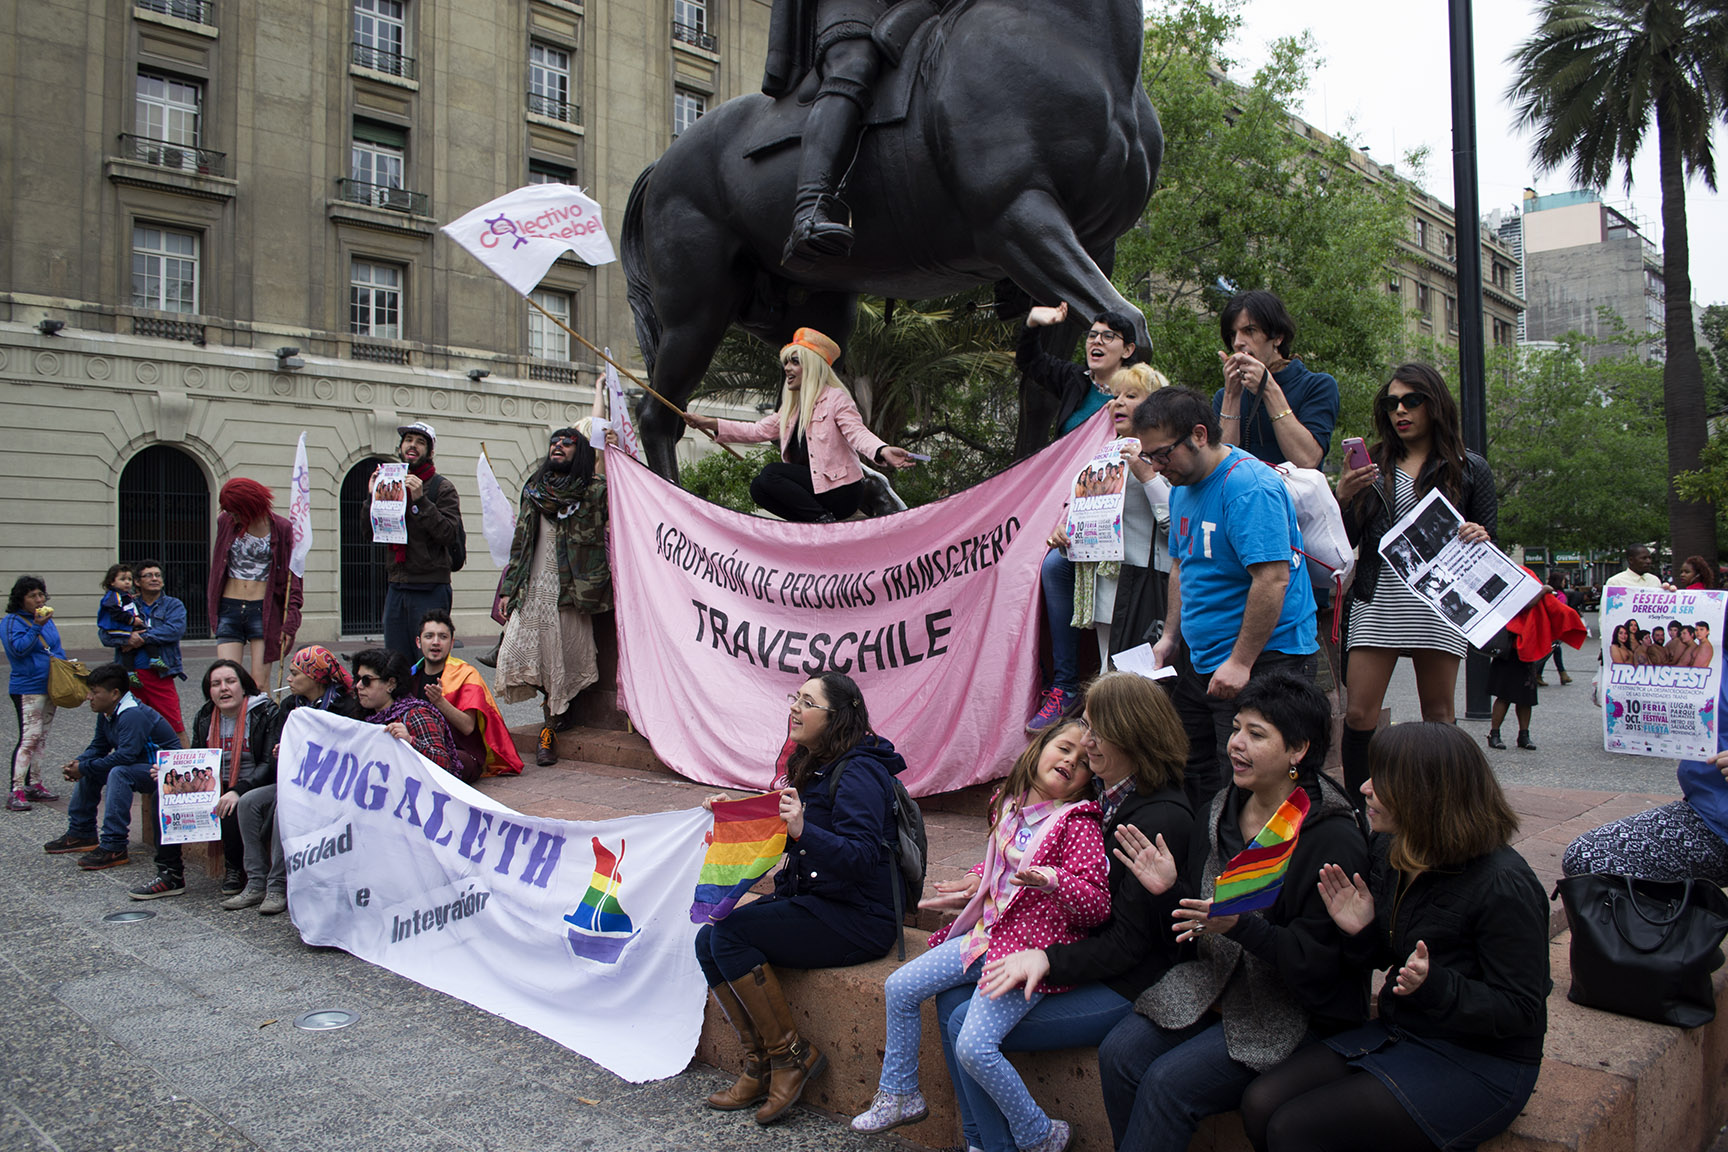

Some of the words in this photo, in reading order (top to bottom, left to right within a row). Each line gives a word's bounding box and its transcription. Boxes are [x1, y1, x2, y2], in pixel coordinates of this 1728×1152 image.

[1073, 493, 1122, 512] TRANSFEST
[1077, 522, 1084, 531] 10
[656, 522, 750, 597] AGRUPACIÓN
[752, 566, 778, 604] DE
[780, 570, 875, 609] PERSONAS
[882, 517, 1020, 601] TRANSGENERO
[1632, 594, 1677, 604] FESTEJA
[1682, 595, 1696, 605] TU
[1632, 605, 1668, 613] DERECHO
[1679, 606, 1694, 614] SER
[692, 599, 952, 676] TRAVESCHILE
[1611, 663, 1712, 689] TRANSFEST
[1626, 700, 1640, 714] 10
[1643, 704, 1666, 712] FERIA
[1625, 714, 1640, 723] OCT.
[1643, 714, 1668, 723] FESTIVAL
[1644, 724, 1669, 734] FIESTA
[164, 791, 216, 806] TRANSFEST
[291, 741, 566, 888] MOGALETH
[356, 888, 370, 907] e
